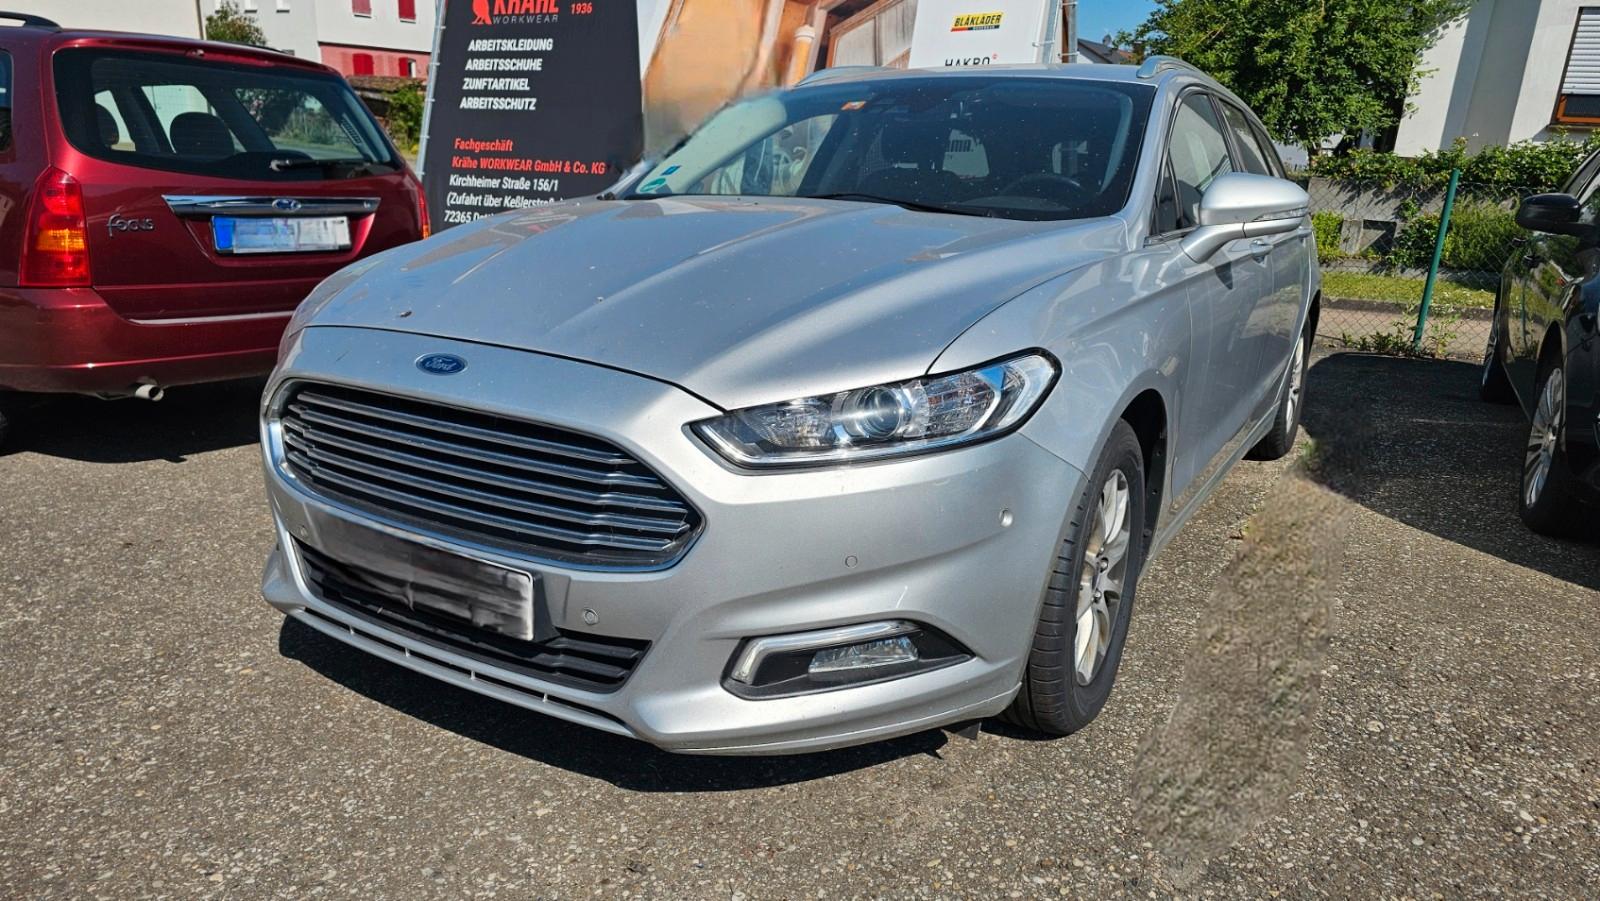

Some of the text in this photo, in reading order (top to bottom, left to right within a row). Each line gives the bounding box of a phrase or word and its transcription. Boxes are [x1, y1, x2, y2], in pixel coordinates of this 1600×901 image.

[571, 2, 593, 14] 1936
[493, 15, 559, 24] WORKWEAR
[467, 38, 553, 51] ARBEITSKLEIDUNG
[464, 58, 543, 71] ARBEITSSCHUHE
[462, 78, 530, 90] ZUNFTARTIKEL
[459, 97, 536, 110] ARBEITSSCHUTZ
[454, 138, 513, 153] Fachgeschäft
[452, 155, 606, 174] Krähe WORKWEAR GmbH & Co. KG
[449, 174, 558, 192] Kirchheimer Straße 156/1
[446, 192, 482, 206] (Zufahrt
[483, 194, 502, 207] über
[443, 210, 472, 224] 72365
[424, 356, 457, 371] Ford
